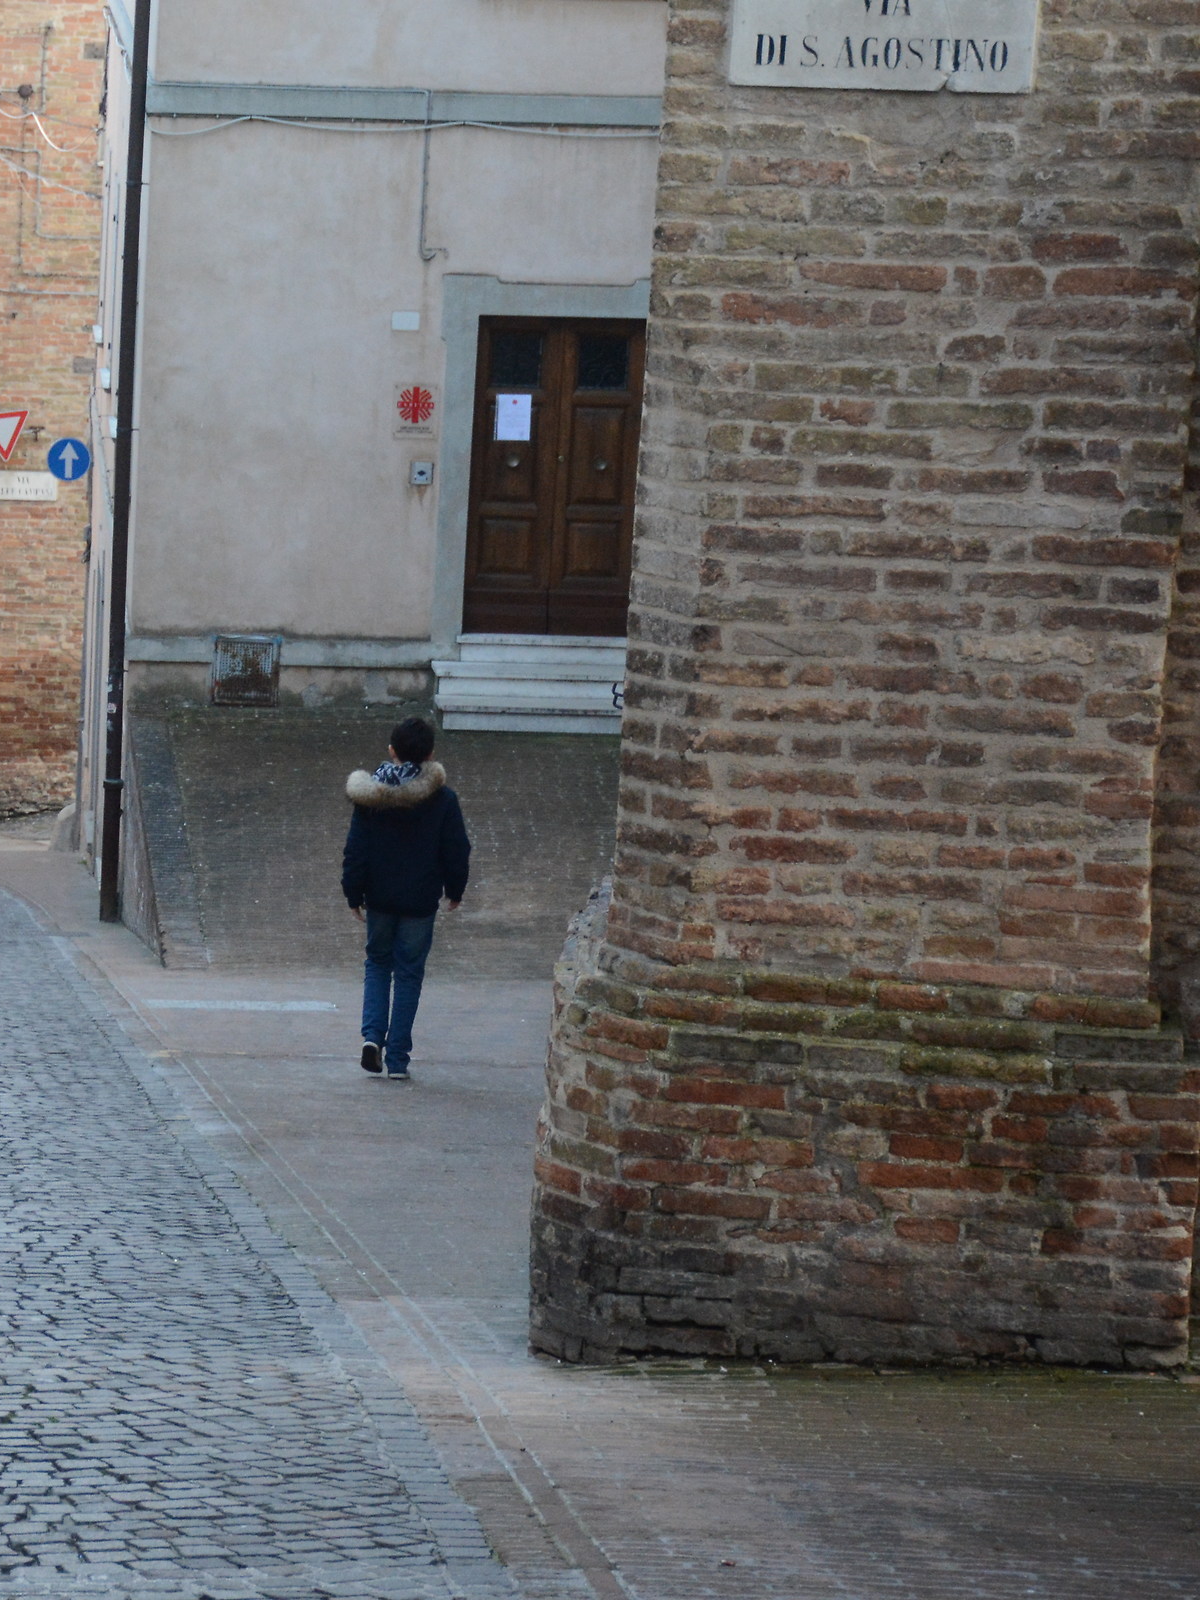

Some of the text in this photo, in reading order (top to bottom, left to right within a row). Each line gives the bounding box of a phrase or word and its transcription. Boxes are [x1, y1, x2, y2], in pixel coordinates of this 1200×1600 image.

[754, 33, 1009, 72] DI S. AGOSTINO
